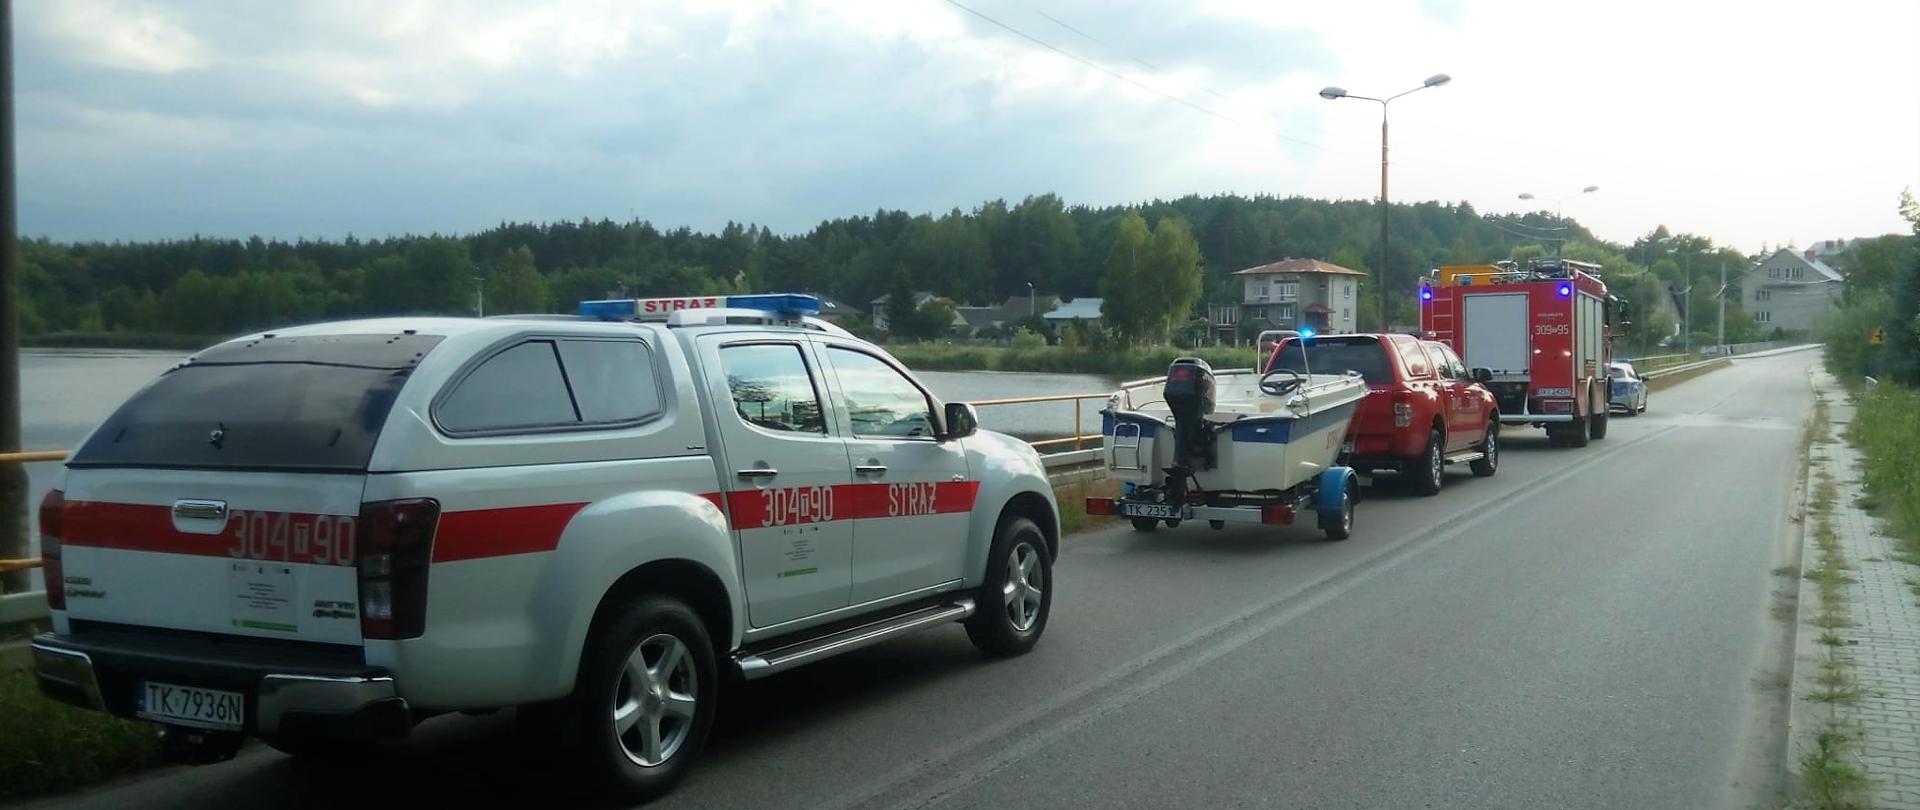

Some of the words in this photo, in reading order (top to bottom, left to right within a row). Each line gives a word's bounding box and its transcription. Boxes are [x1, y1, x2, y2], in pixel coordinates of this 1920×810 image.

[1128, 504, 1142, 515] TK
[149, 684, 174, 714] TK
[181, 689, 241, 723] 7936N
